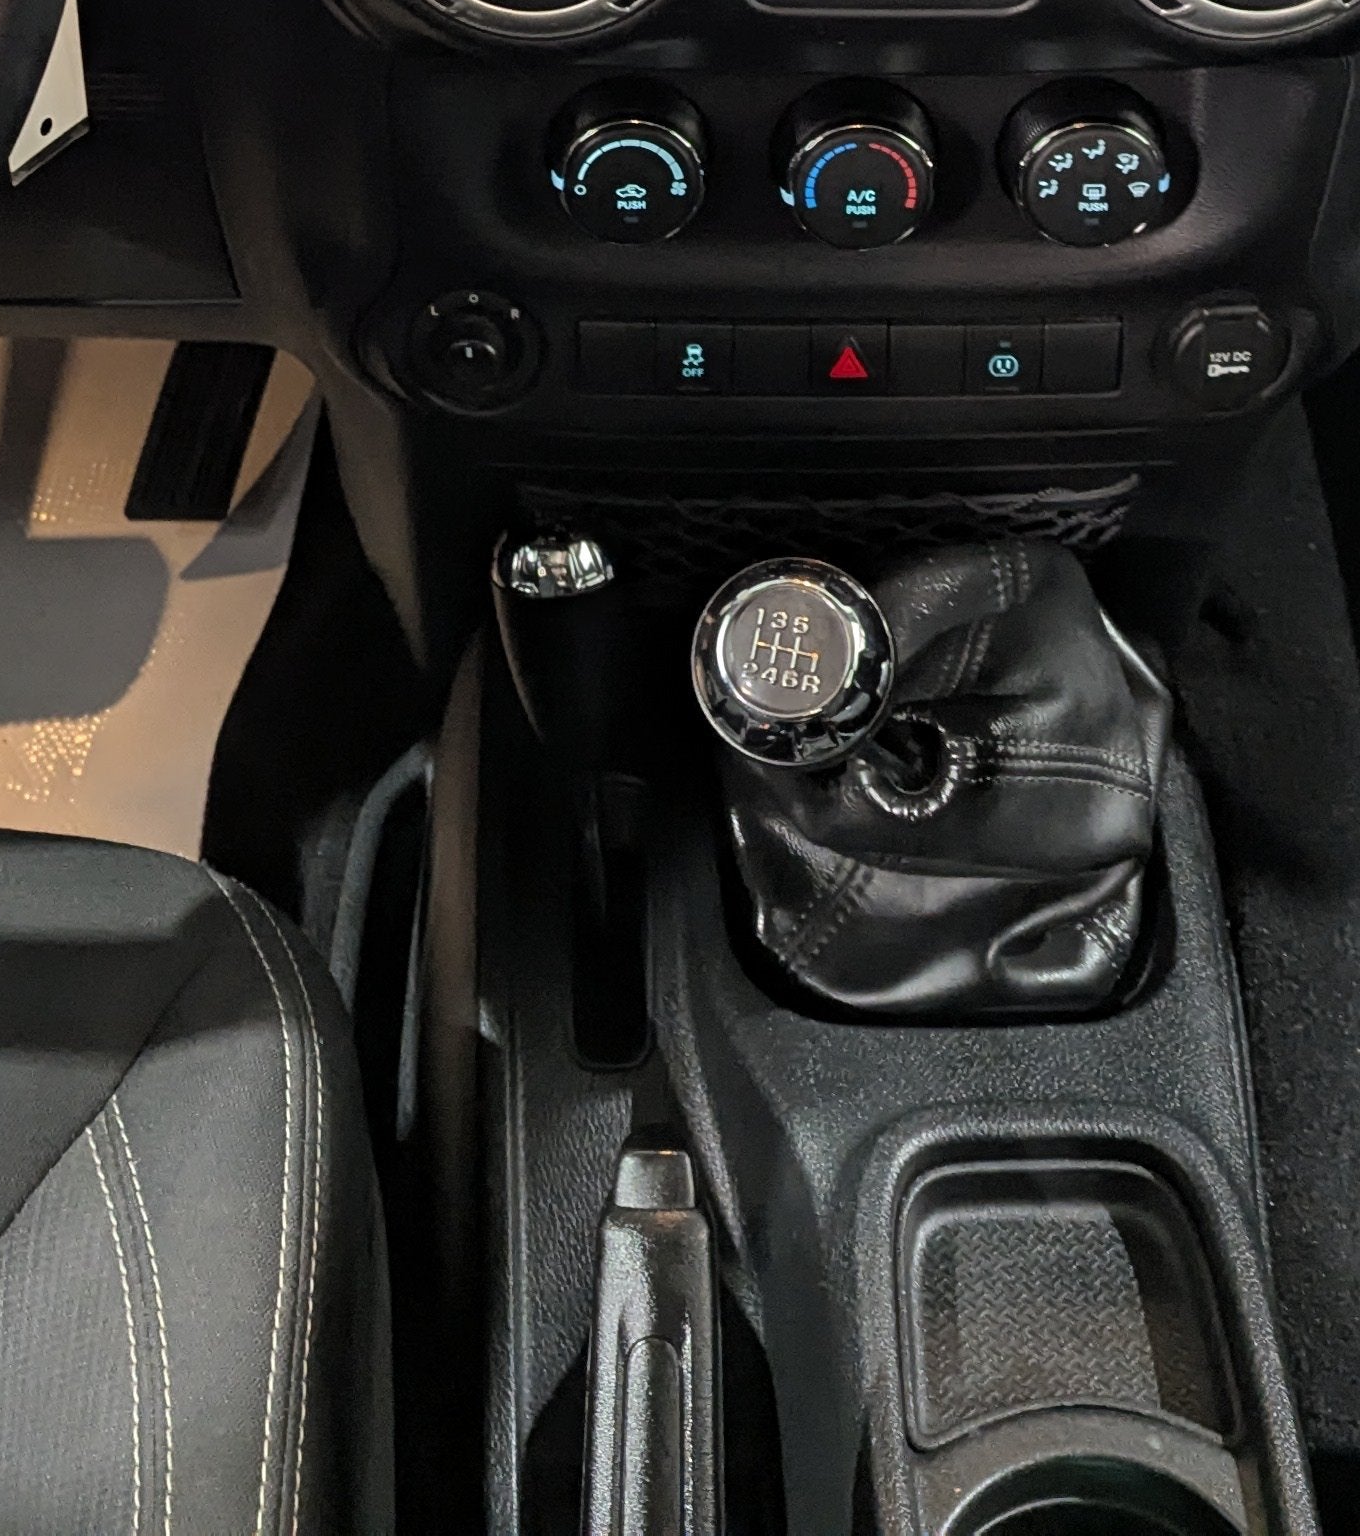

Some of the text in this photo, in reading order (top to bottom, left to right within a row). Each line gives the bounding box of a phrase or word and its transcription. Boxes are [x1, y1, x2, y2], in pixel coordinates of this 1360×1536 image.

[848, 190, 875, 206] A/C
[617, 201, 646, 209] PUSH
[846, 205, 876, 215] PUSH
[1079, 199, 1108, 211] PUSH
[1233, 351, 1251, 361] DC
[683, 368, 704, 377] OFF
[769, 611, 788, 630] 3
[801, 673, 821, 695] R
